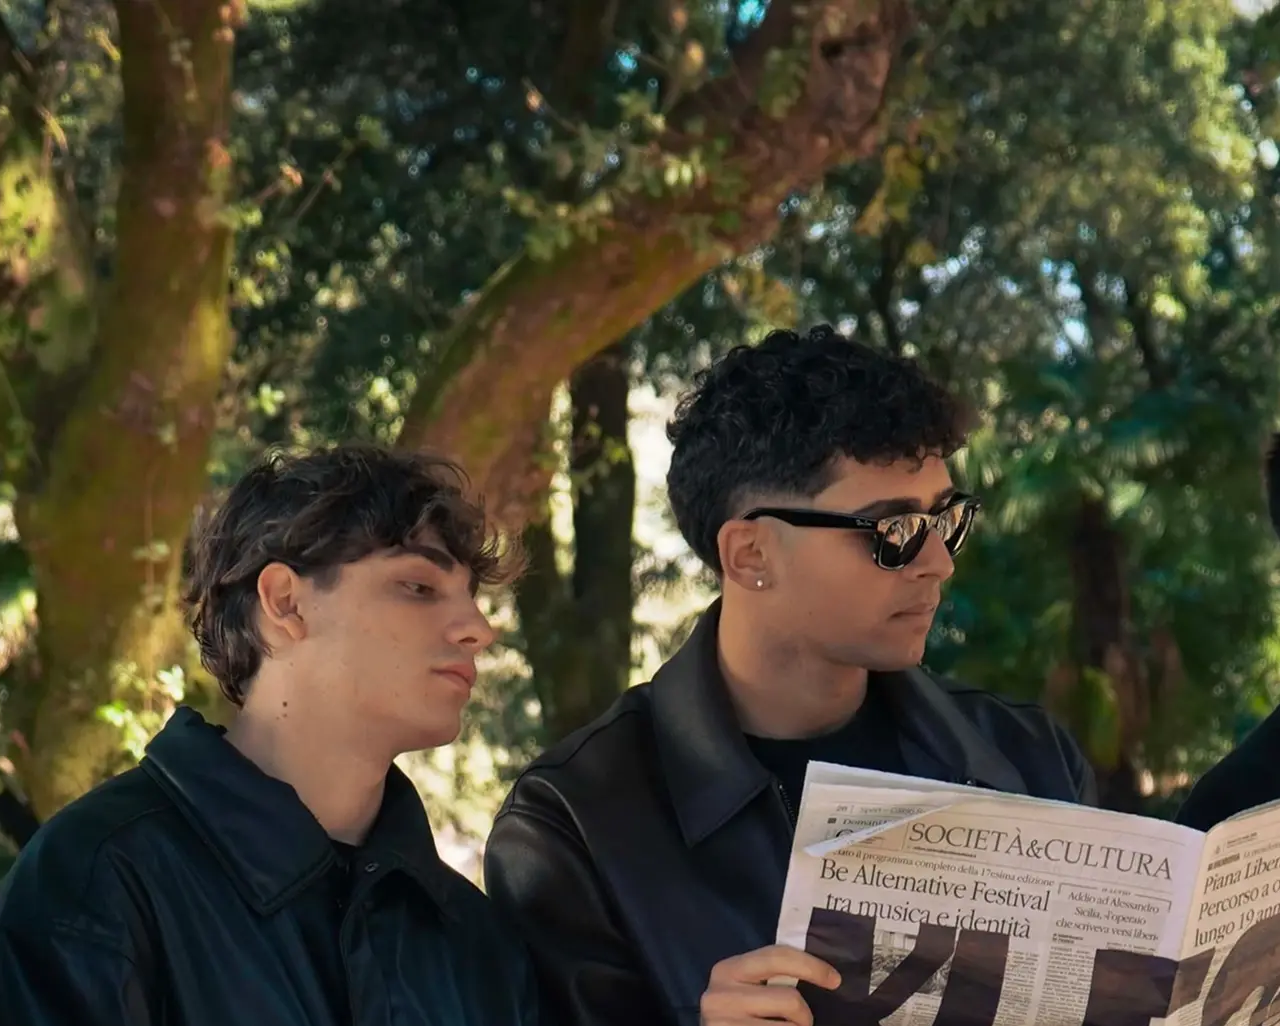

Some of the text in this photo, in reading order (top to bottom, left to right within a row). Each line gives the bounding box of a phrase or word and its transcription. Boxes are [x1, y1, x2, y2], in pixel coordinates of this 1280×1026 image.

[855, 849, 862, 859] il
[863, 851, 913, 866] programma
[914, 859, 957, 874] completo
[957, 864, 979, 876] della
[980, 868, 1016, 881] 17esima
[1017, 871, 1055, 888] edizione
[908, 821, 1173, 881] SOCIETÀ&CULTURA
[819, 857, 1050, 913] Be Alternative Festival
[1203, 864, 1242, 895] Piana
[825, 892, 853, 914] tra
[858, 900, 931, 924] musica
[936, 910, 950, 926] e
[954, 908, 1032, 940] identità
[1067, 891, 1160, 914] Addio ad Alessandro
[1073, 906, 1102, 920] Sicilia,
[1198, 884, 1260, 921] Percorso
[1261, 884, 1270, 899] a
[1055, 917, 1073, 928] che
[1074, 921, 1110, 934] scriveva
[1111, 926, 1132, 937] versi
[1193, 922, 1235, 948] lungo
[1239, 906, 1255, 926] 19
